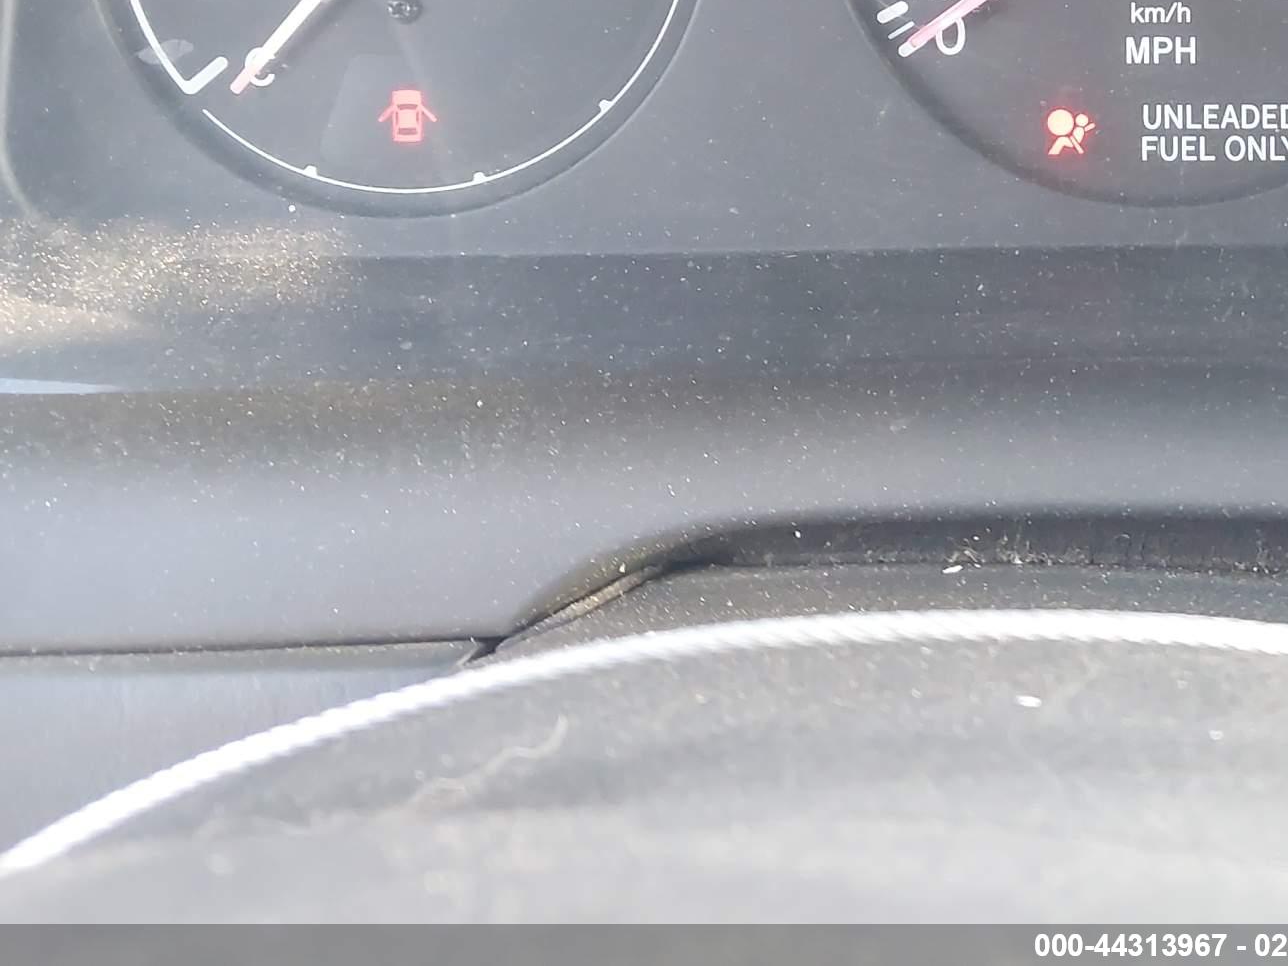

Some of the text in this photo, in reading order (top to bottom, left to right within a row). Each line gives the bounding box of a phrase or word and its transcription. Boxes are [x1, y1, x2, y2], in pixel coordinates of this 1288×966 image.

[1130, 2, 1191, 23] km/h
[935, 17, 966, 56] 0
[1125, 36, 1196, 65] MPH
[1141, 136, 1216, 162] FUEL
